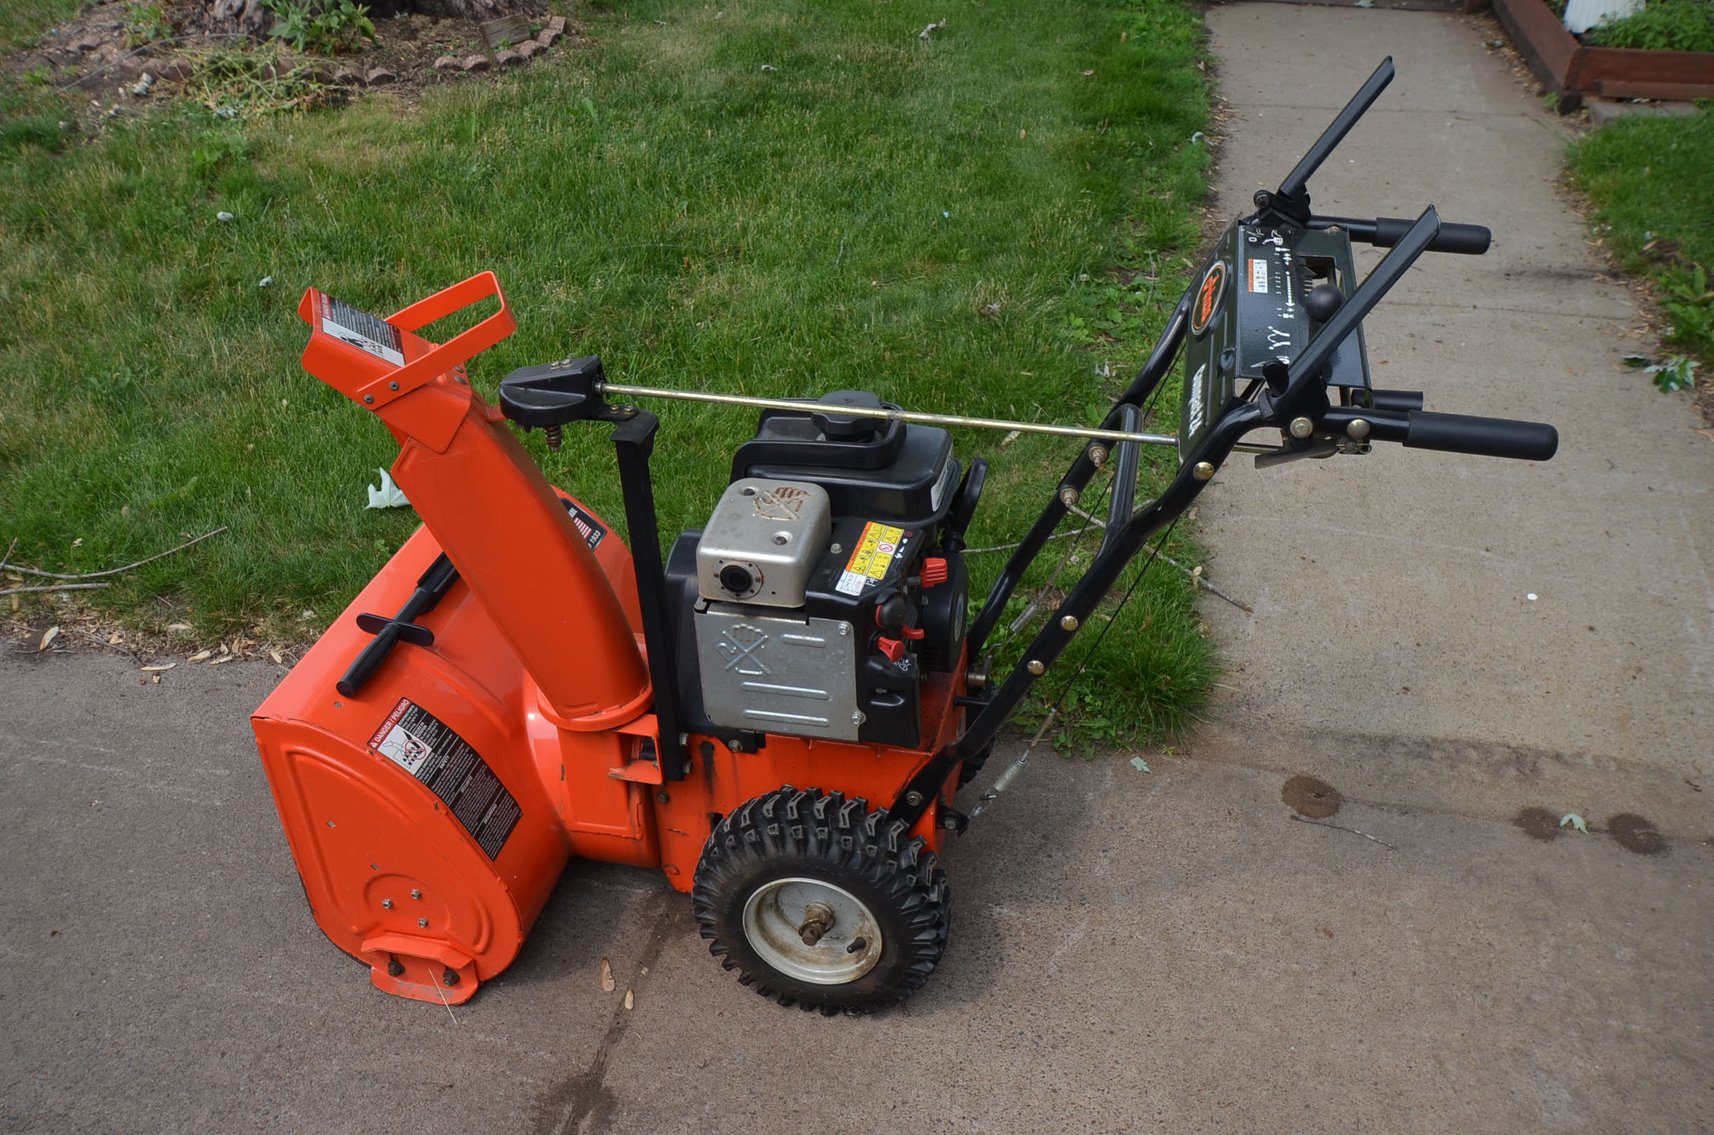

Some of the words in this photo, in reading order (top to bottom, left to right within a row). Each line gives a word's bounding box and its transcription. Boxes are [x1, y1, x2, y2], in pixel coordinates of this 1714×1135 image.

[374, 721, 393, 743] DANGER
[392, 699, 410, 721] PELIGRO
[439, 755, 450, 770] SAFETY
